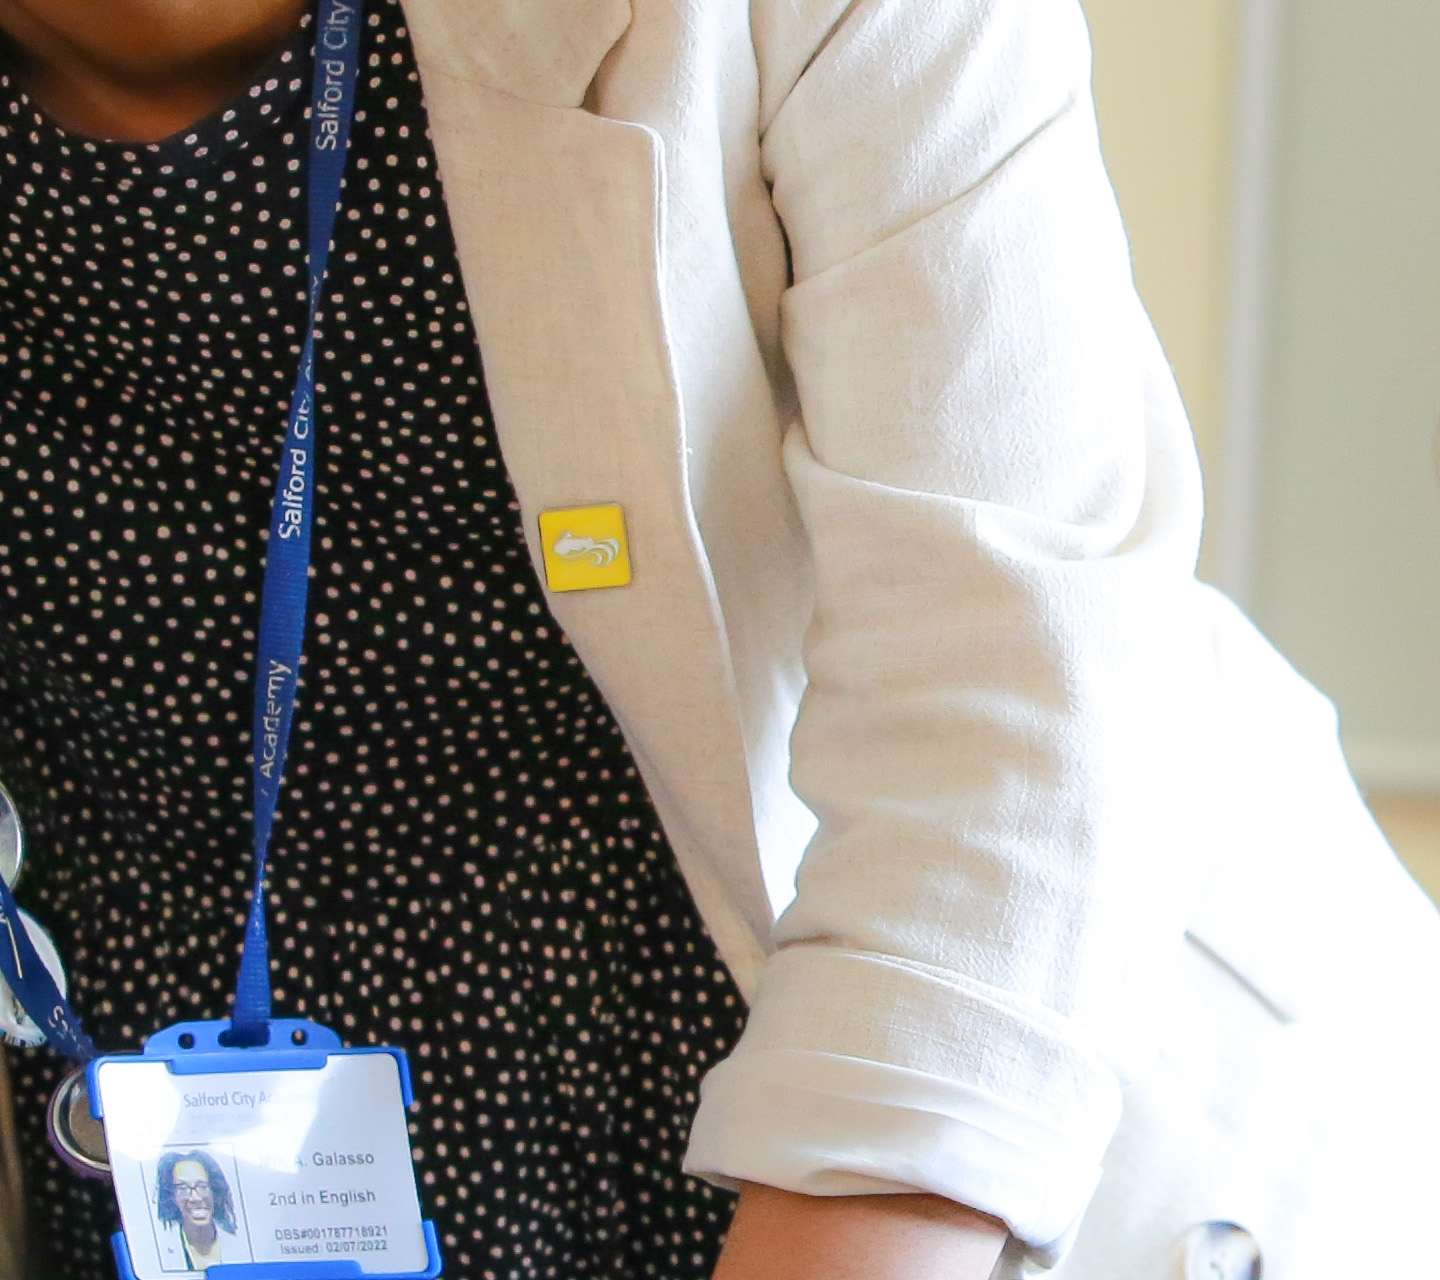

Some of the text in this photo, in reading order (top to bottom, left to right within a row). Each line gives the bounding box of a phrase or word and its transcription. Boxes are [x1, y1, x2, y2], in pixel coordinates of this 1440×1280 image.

[323, 0, 356, 51] City
[315, 59, 345, 151] Salford
[277, 448, 307, 540] Salford
[259, 659, 293, 780] Academy
[183, 1091, 229, 1108] Salford
[231, 1090, 256, 1108] City
[312, 1151, 375, 1167] Galasso
[268, 1188, 377, 1207] 2nd in English
